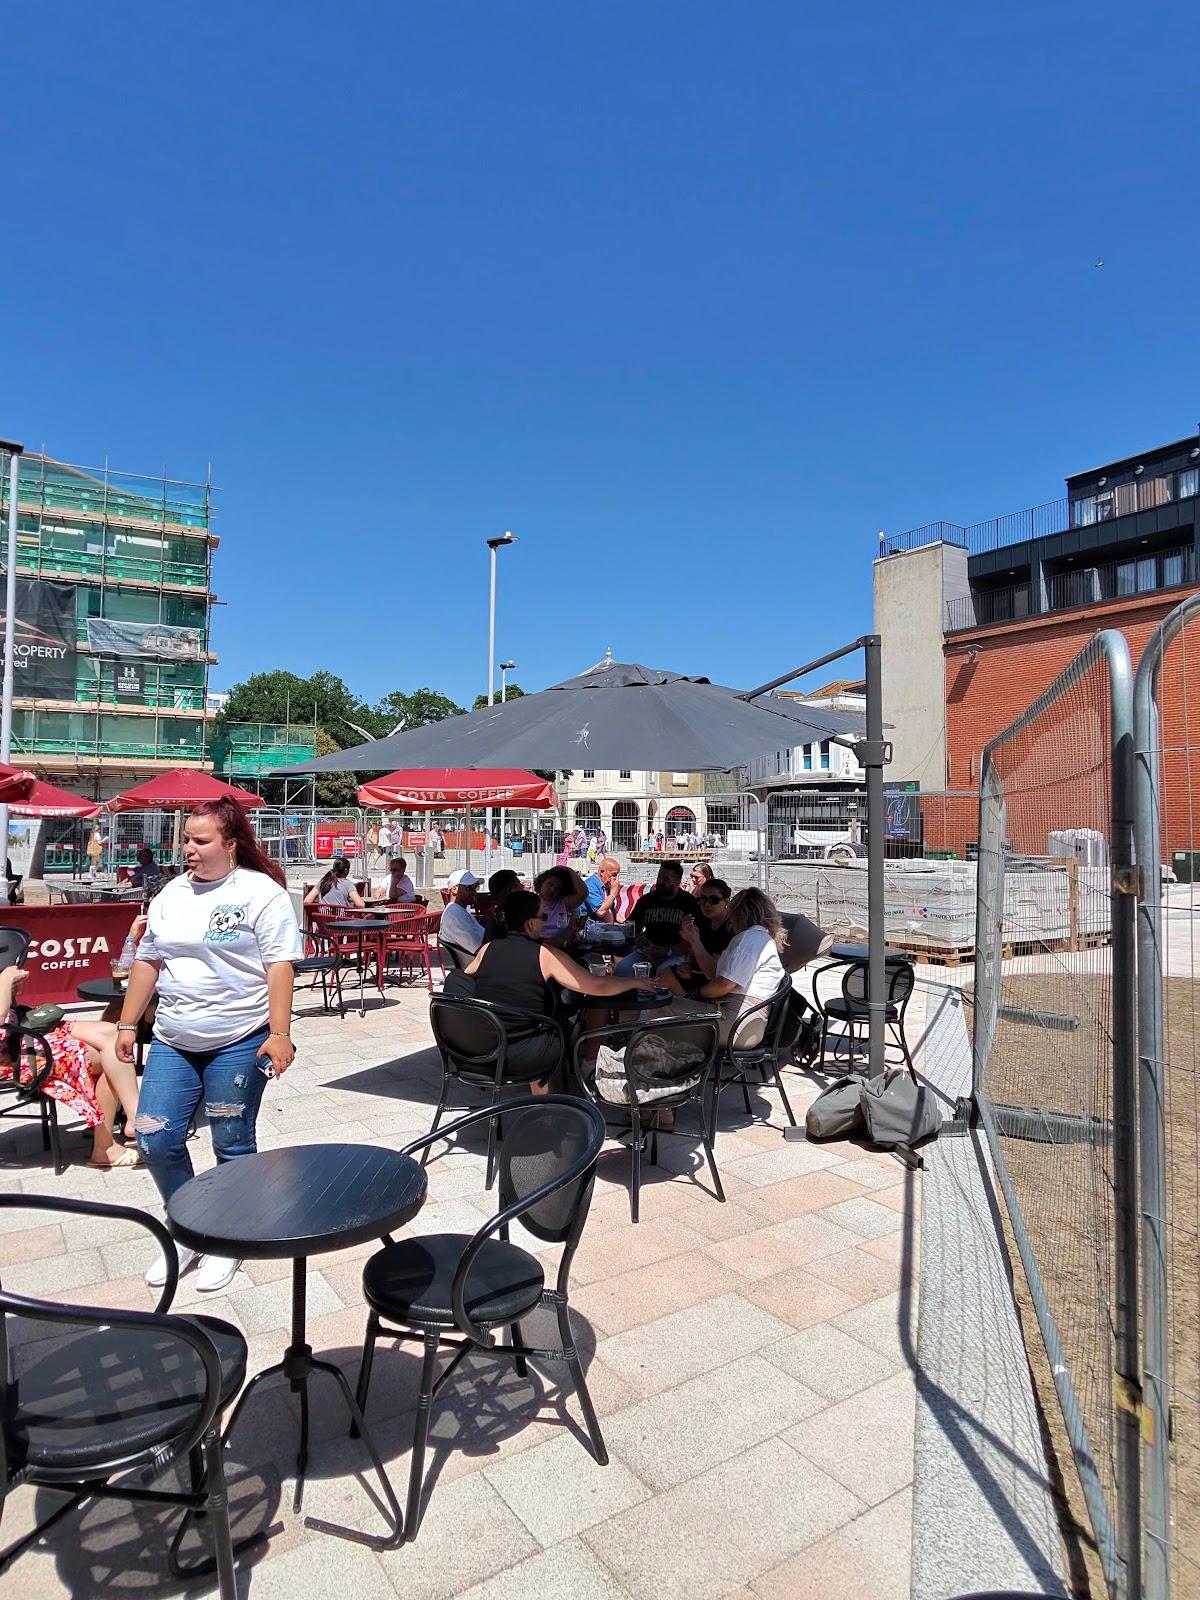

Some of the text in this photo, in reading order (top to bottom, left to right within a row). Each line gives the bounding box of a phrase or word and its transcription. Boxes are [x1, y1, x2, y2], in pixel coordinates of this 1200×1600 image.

[398, 790, 515, 801] COSTA COFFEE
[27, 936, 110, 959] COSTA
[41, 959, 90, 970] COFFEE
